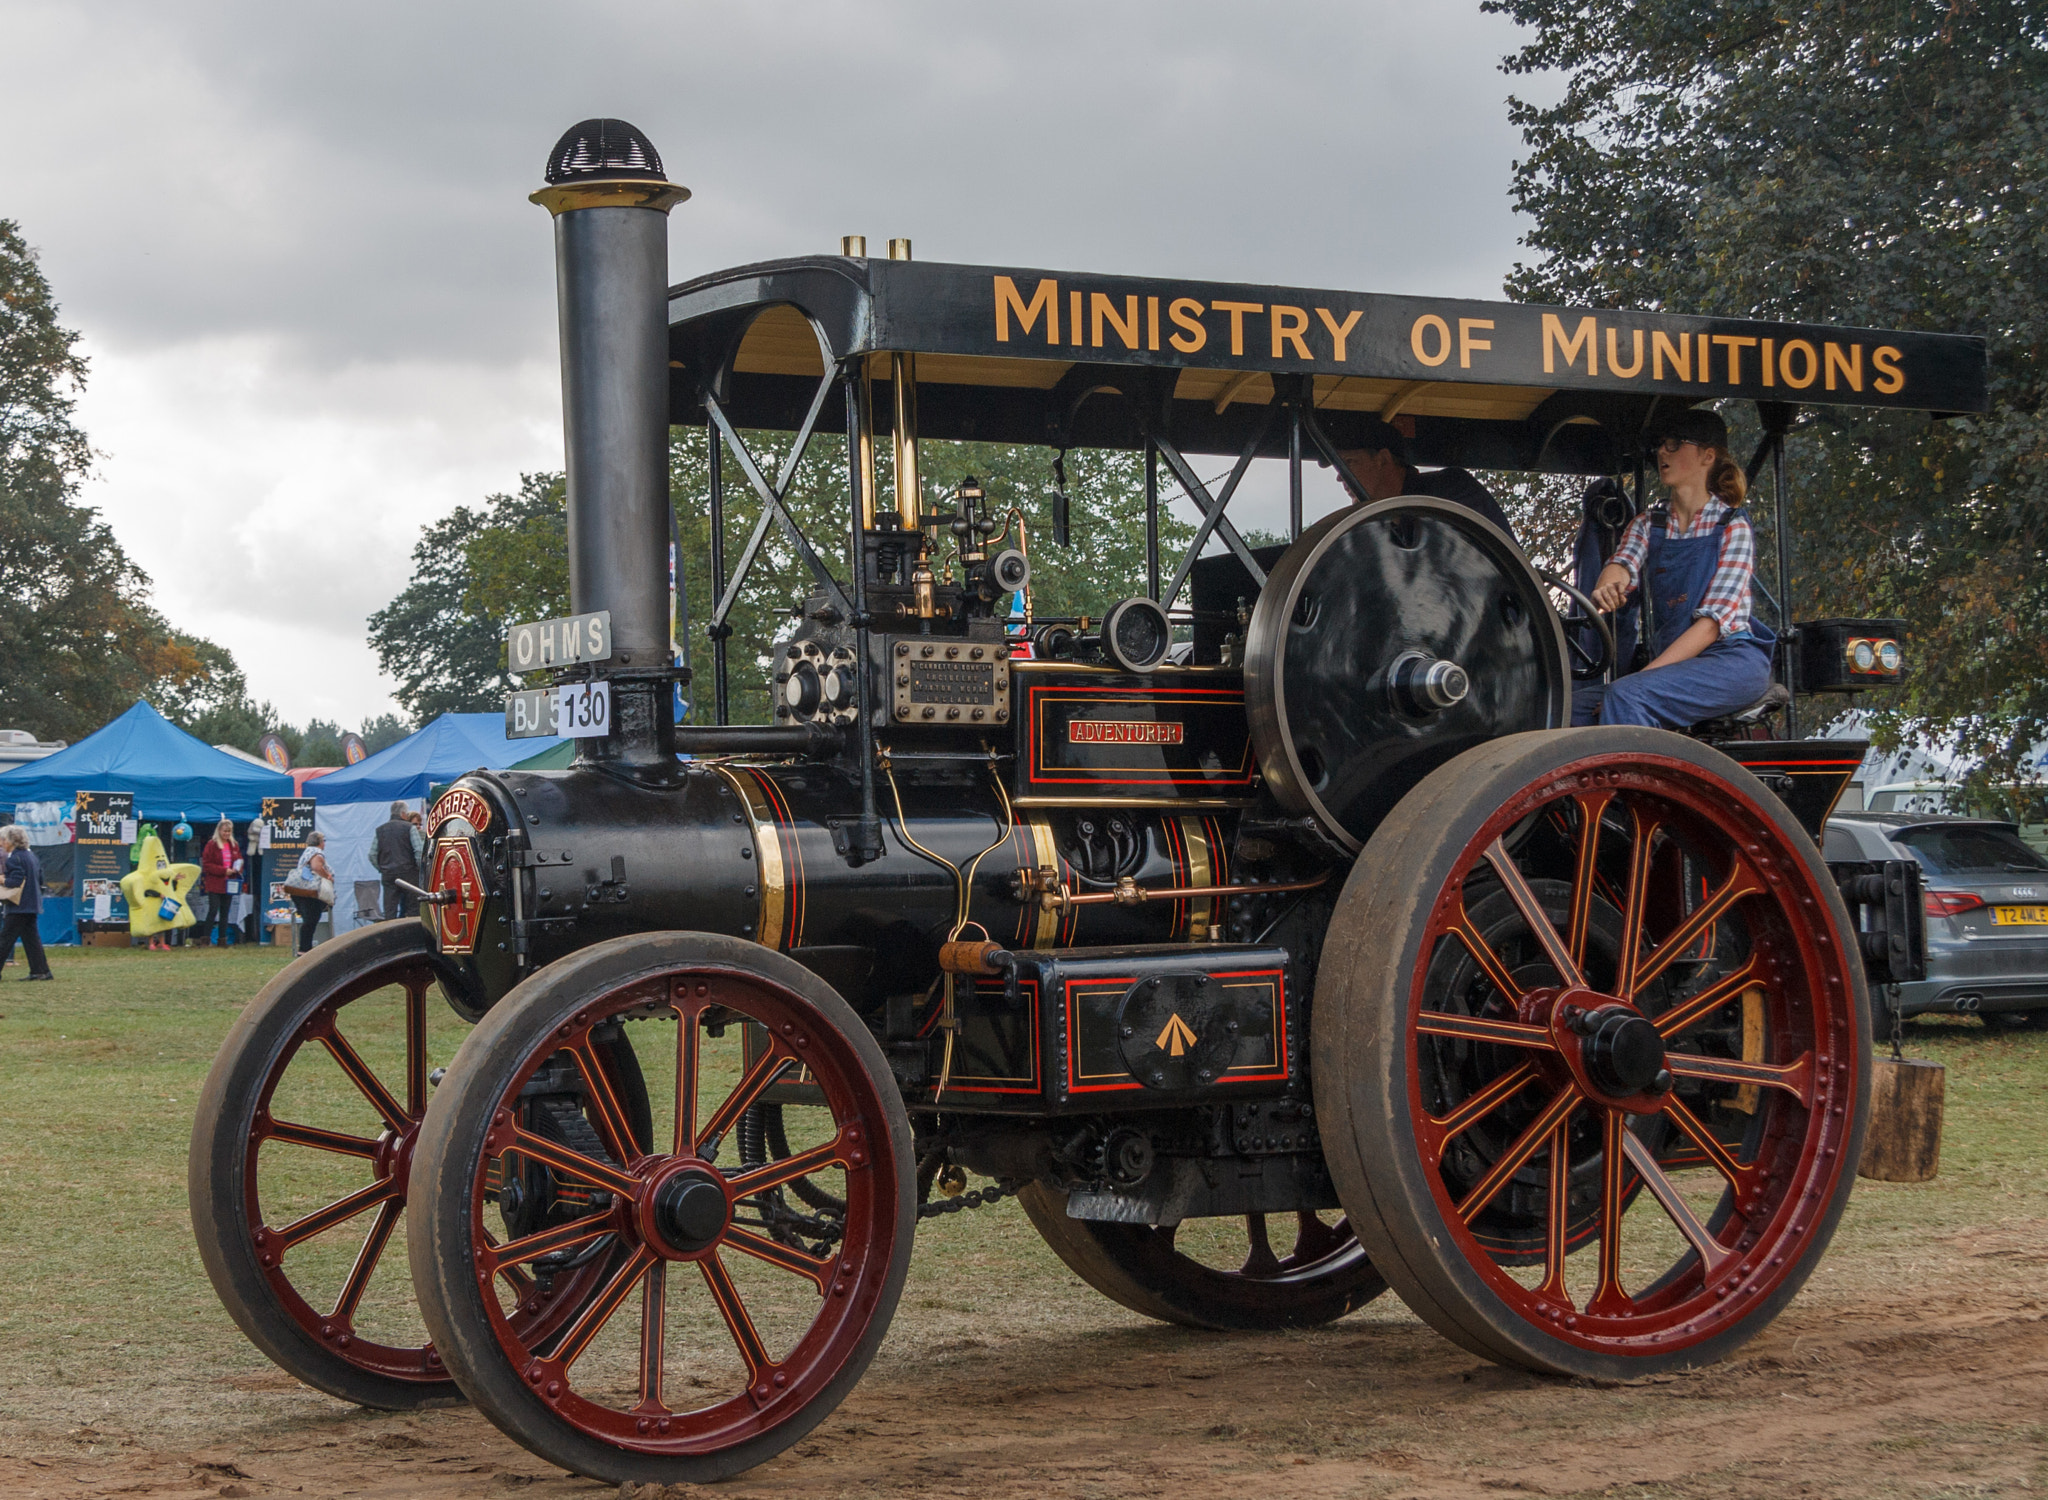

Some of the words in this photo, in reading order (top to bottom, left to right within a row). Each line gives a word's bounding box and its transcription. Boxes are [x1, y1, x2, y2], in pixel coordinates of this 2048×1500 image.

[993, 274, 1364, 362] MINISTRY
[1410, 313, 1496, 370] OF
[1541, 313, 1906, 395] MUNITIONS
[514, 696, 540, 732] BJ
[564, 690, 605, 728] 130
[1075, 723, 1177, 742] ADVENTURER
[429, 793, 484, 832] GARRETT
[89, 820, 116, 834] hike
[275, 826, 300, 838] hike
[2000, 908, 2018, 922] T2
